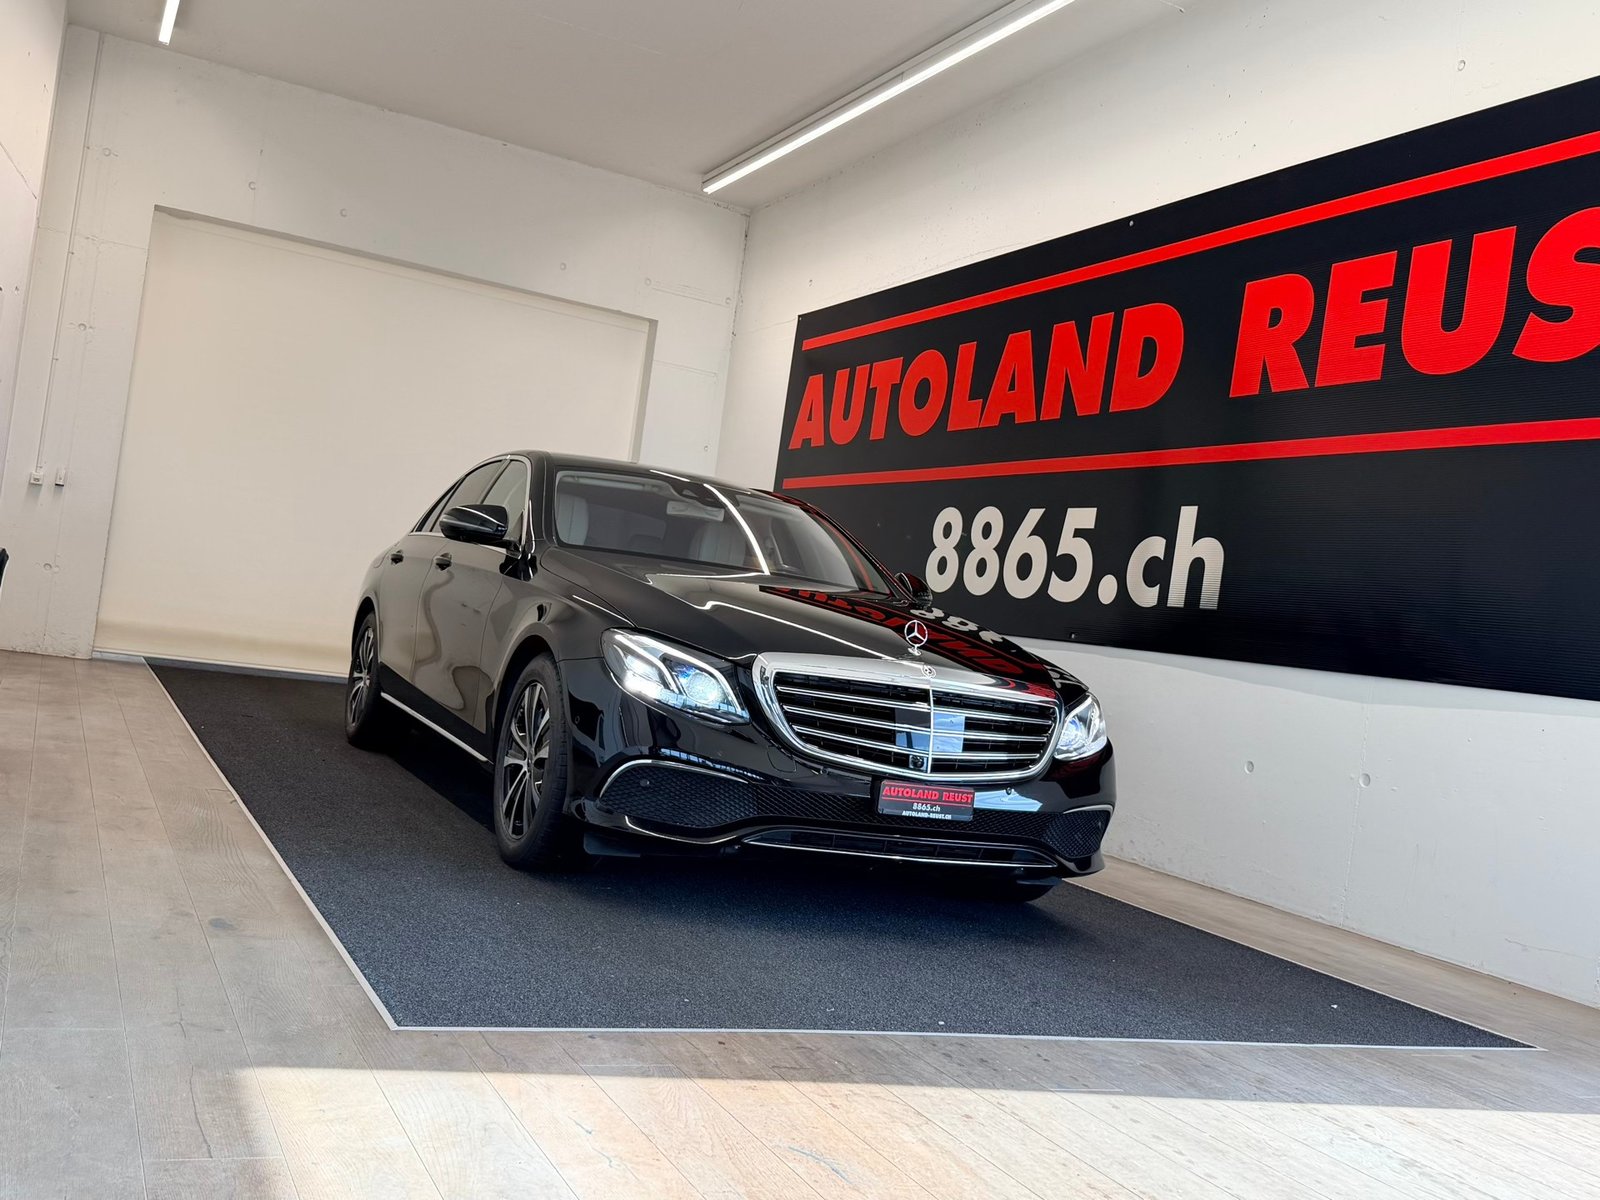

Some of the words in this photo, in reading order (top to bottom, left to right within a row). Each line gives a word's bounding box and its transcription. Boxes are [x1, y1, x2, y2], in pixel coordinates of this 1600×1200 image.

[789, 302, 1184, 450] AUTOLAND
[925, 505, 1225, 610] 8865.ch
[883, 787, 939, 800] AUTOLAND
[942, 792, 973, 803] REUST
[912, 803, 941, 812] 8865.ch
